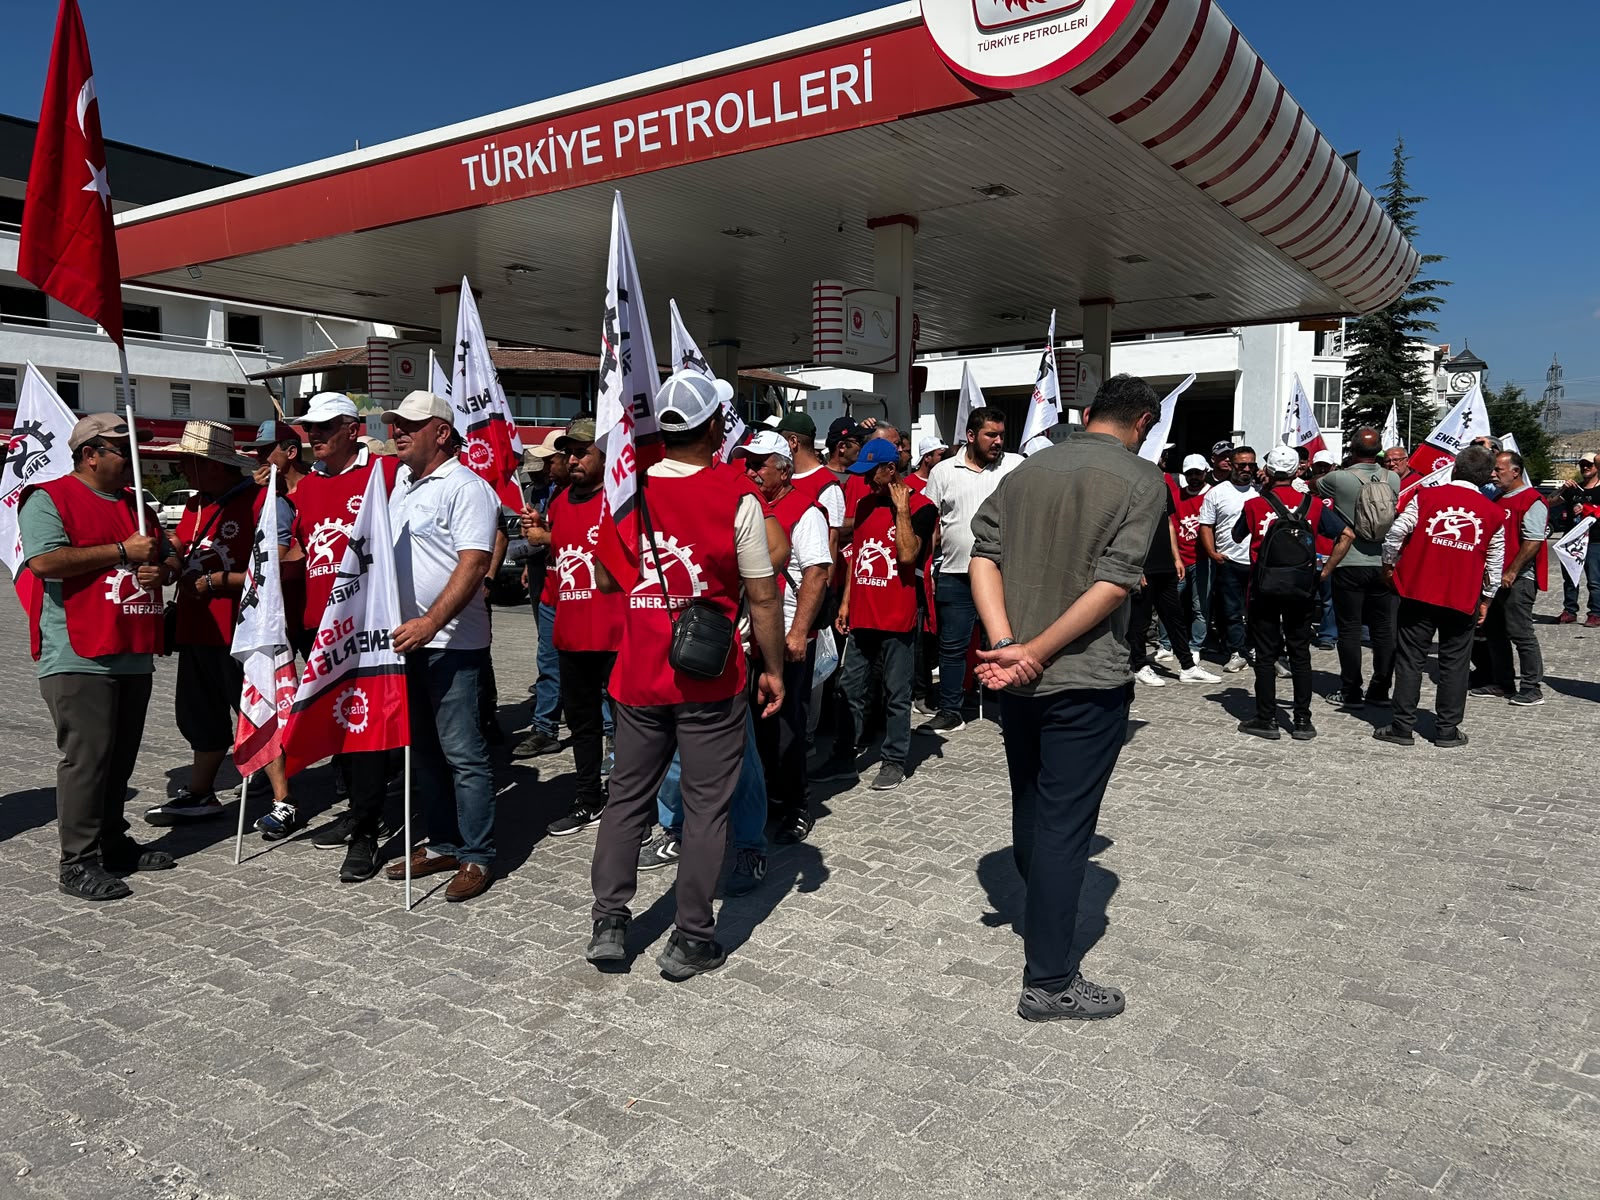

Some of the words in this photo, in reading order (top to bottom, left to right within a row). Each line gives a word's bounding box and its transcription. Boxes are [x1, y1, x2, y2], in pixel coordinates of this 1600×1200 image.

[977, 34, 1020, 52] TÜRKİYE
[1022, 15, 1088, 42] PETROLLERİ
[461, 125, 602, 192] TÜRKİYE
[614, 48, 874, 158] PETROLLERİ
